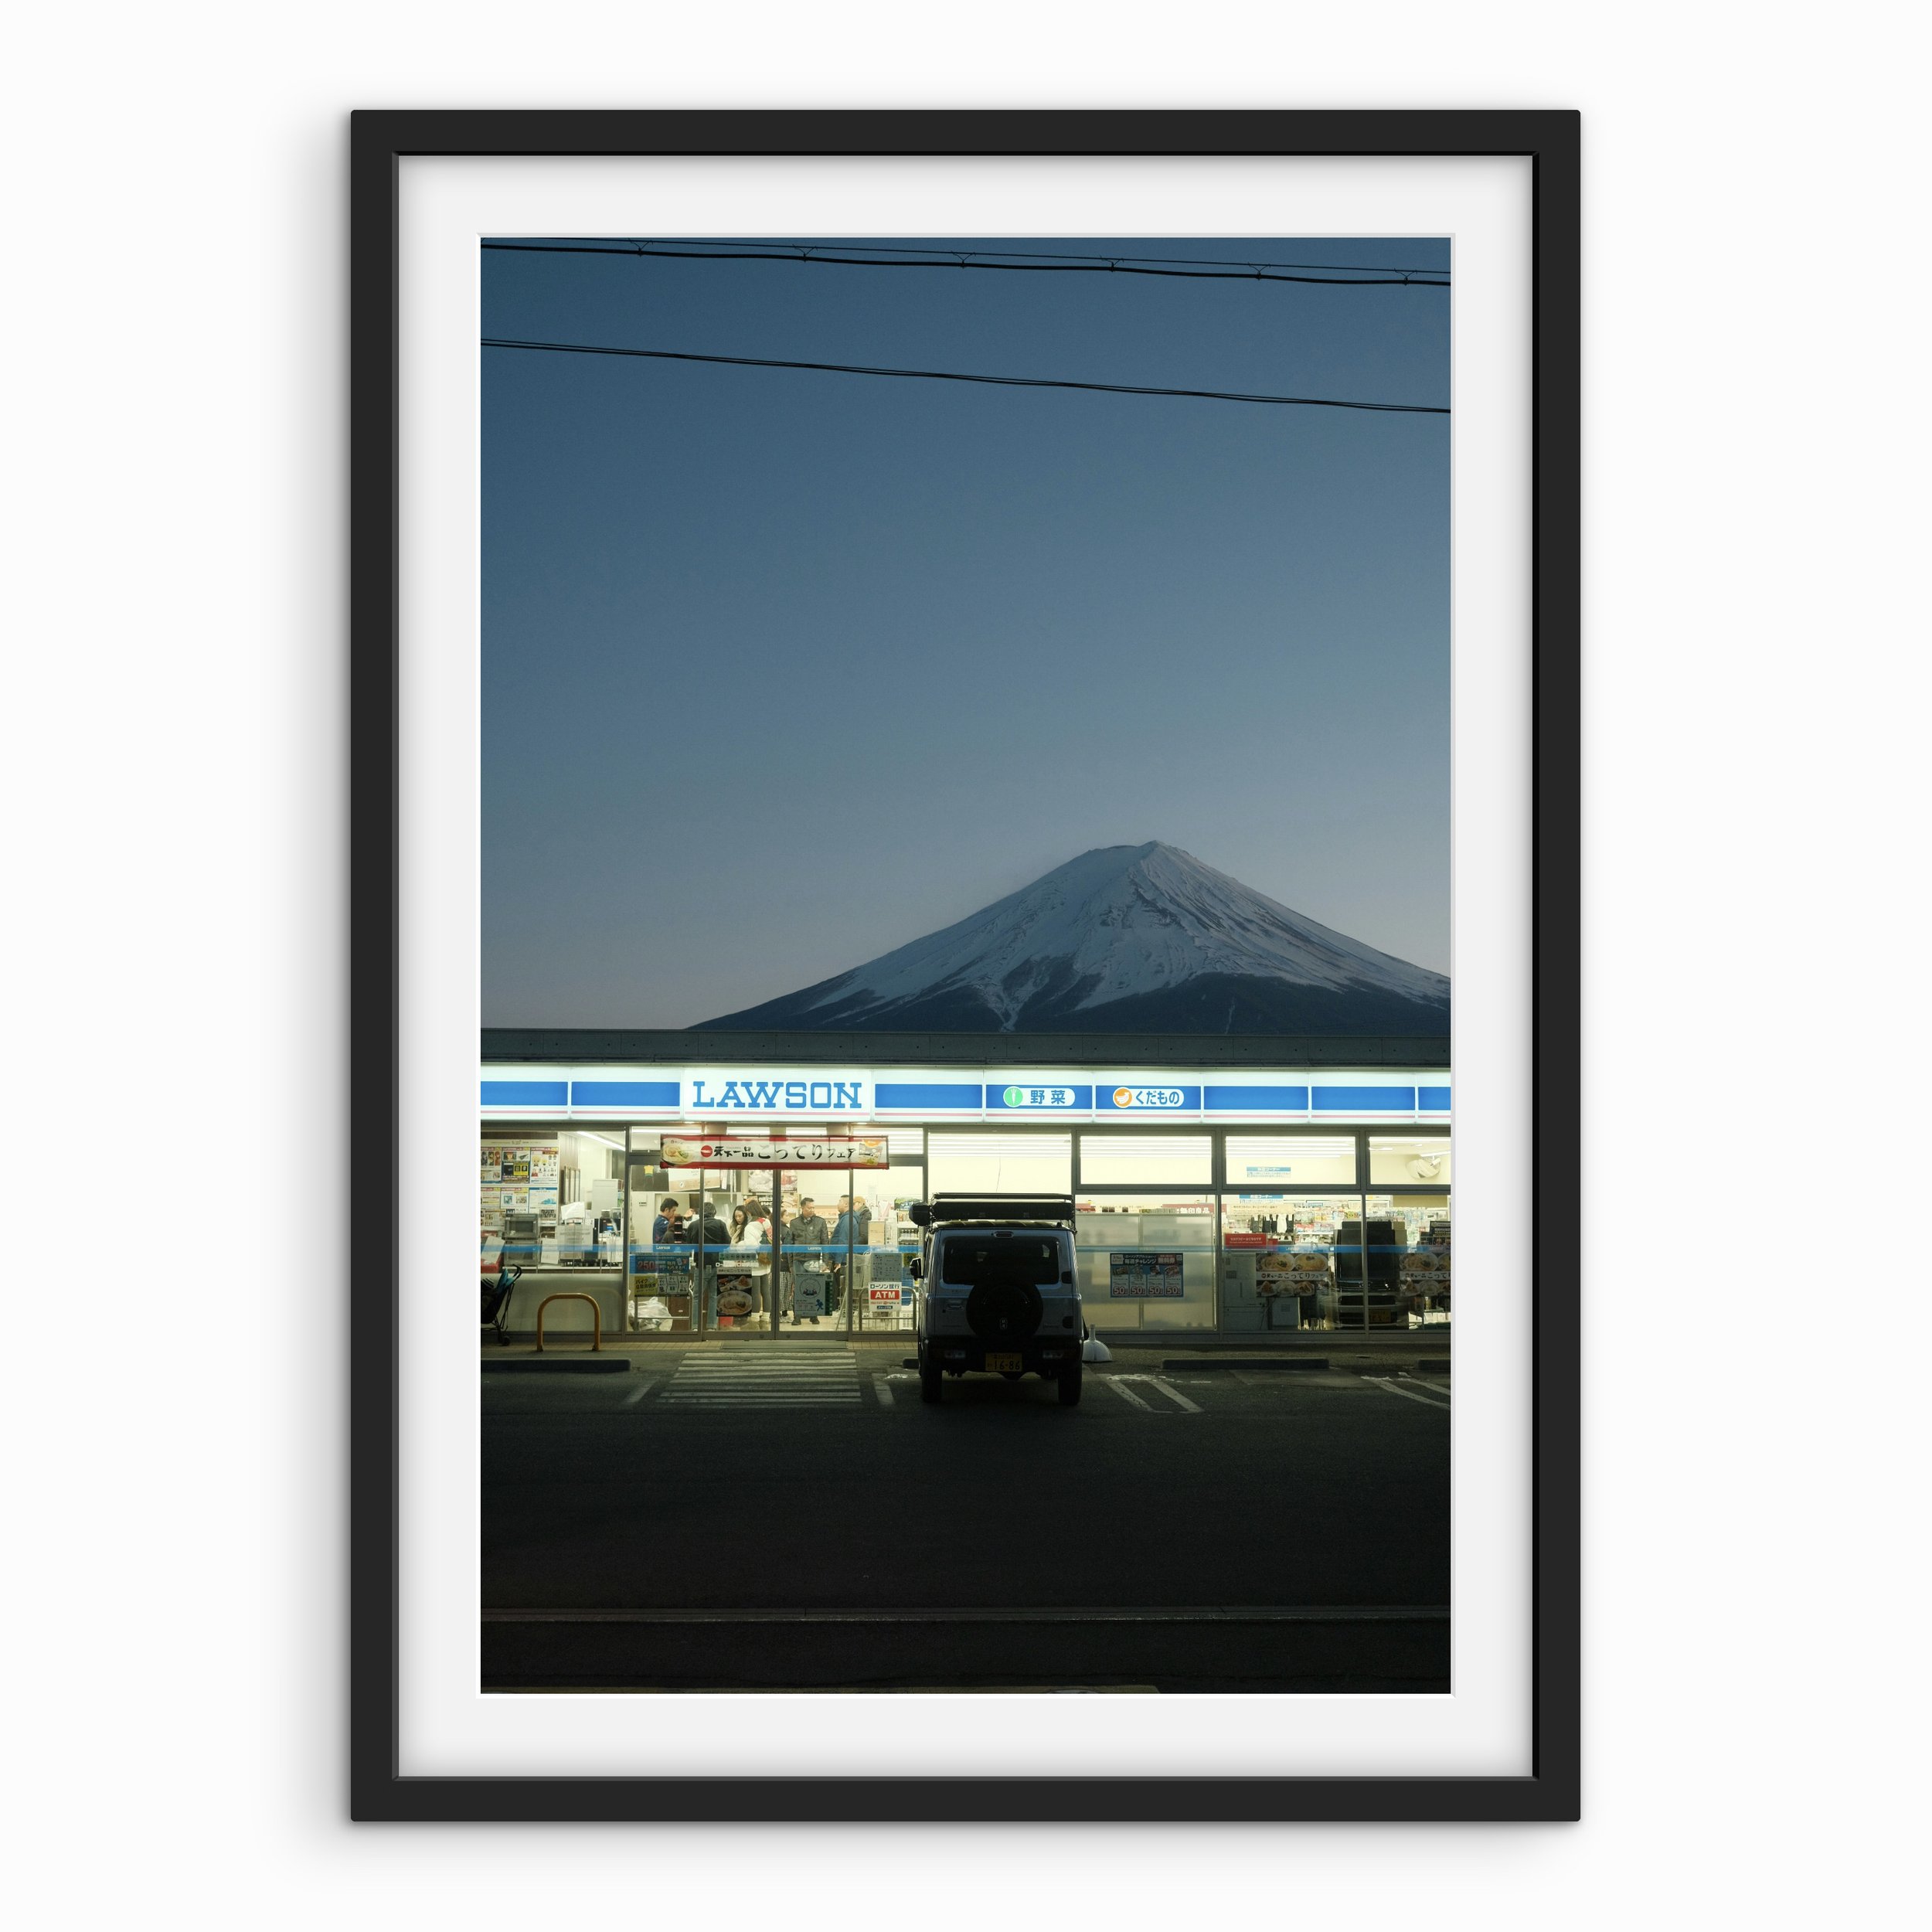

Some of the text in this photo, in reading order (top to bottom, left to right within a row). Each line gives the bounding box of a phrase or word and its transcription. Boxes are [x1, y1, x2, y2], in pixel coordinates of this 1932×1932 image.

[692, 1081, 862, 1109] LAWSON
[1030, 1090, 1066, 1104] 野菜
[1135, 1090, 1179, 1105] くだもの
[638, 1260, 655, 1270] 250
